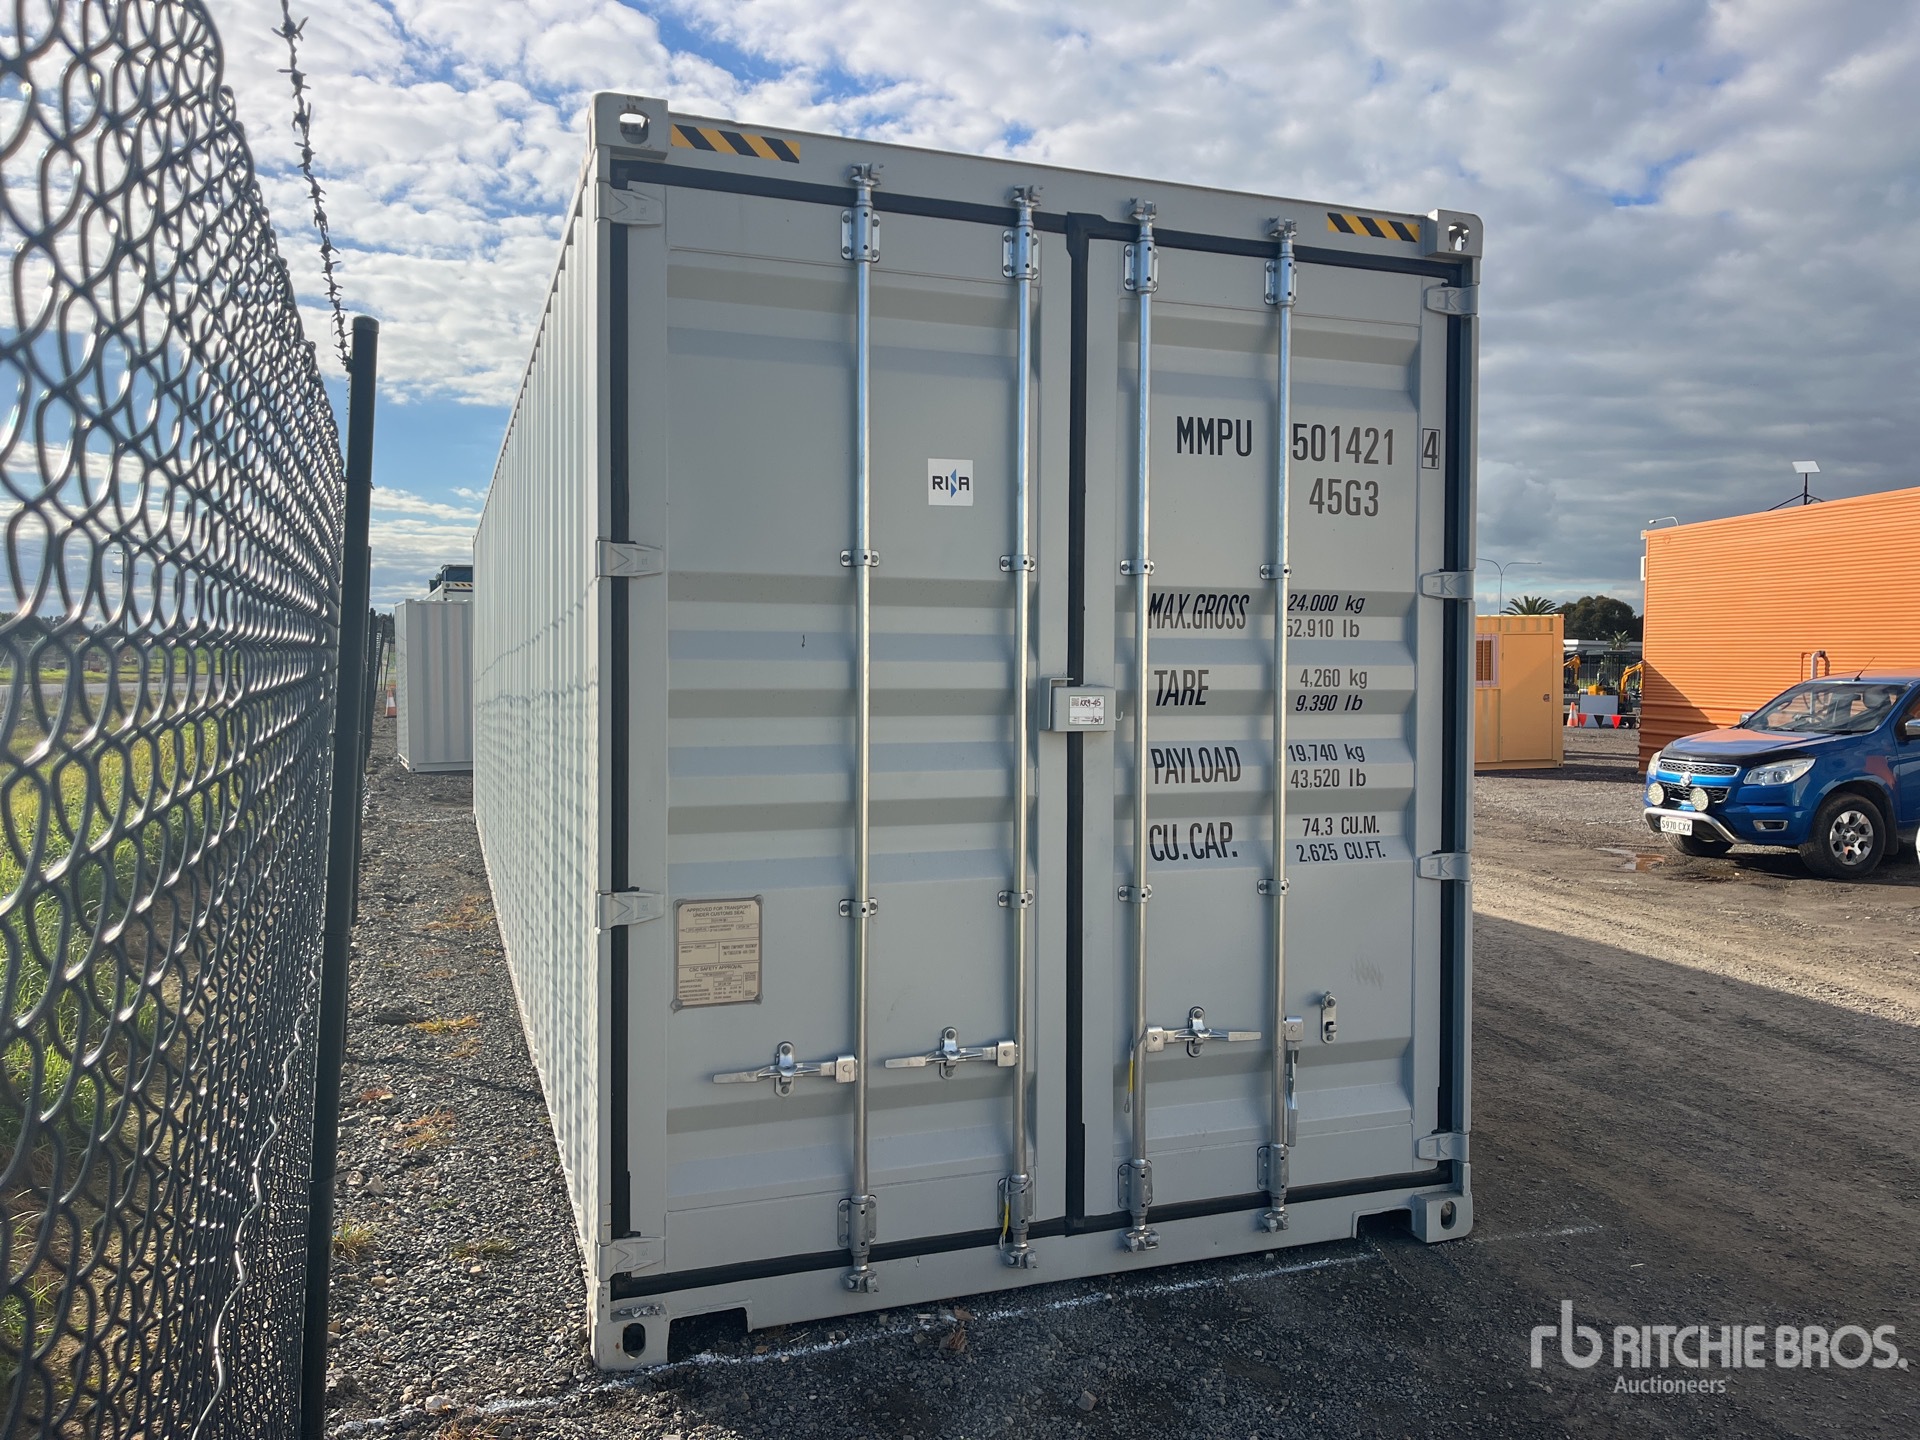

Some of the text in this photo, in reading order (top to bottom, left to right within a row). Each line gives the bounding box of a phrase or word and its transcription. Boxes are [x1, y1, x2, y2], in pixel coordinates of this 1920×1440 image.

[1176, 416, 1438, 467] MMPU 501421 4
[1309, 478, 1379, 516] 45G3
[1148, 593, 1366, 629] MAX.GROSS 24,000 kg
[1343, 619, 1360, 637] lb
[1154, 669, 1368, 706] TARE 4,260 kg
[1295, 694, 1363, 711] 9,390 lb
[1150, 744, 1365, 784] PAYLOAD 19,740 kg
[1290, 768, 1366, 788] 43,520 lb
[1149, 815, 1380, 861] CU.CAP. 74.3 CU.M.
[1296, 841, 1386, 862] 2,625 CU.FT.
